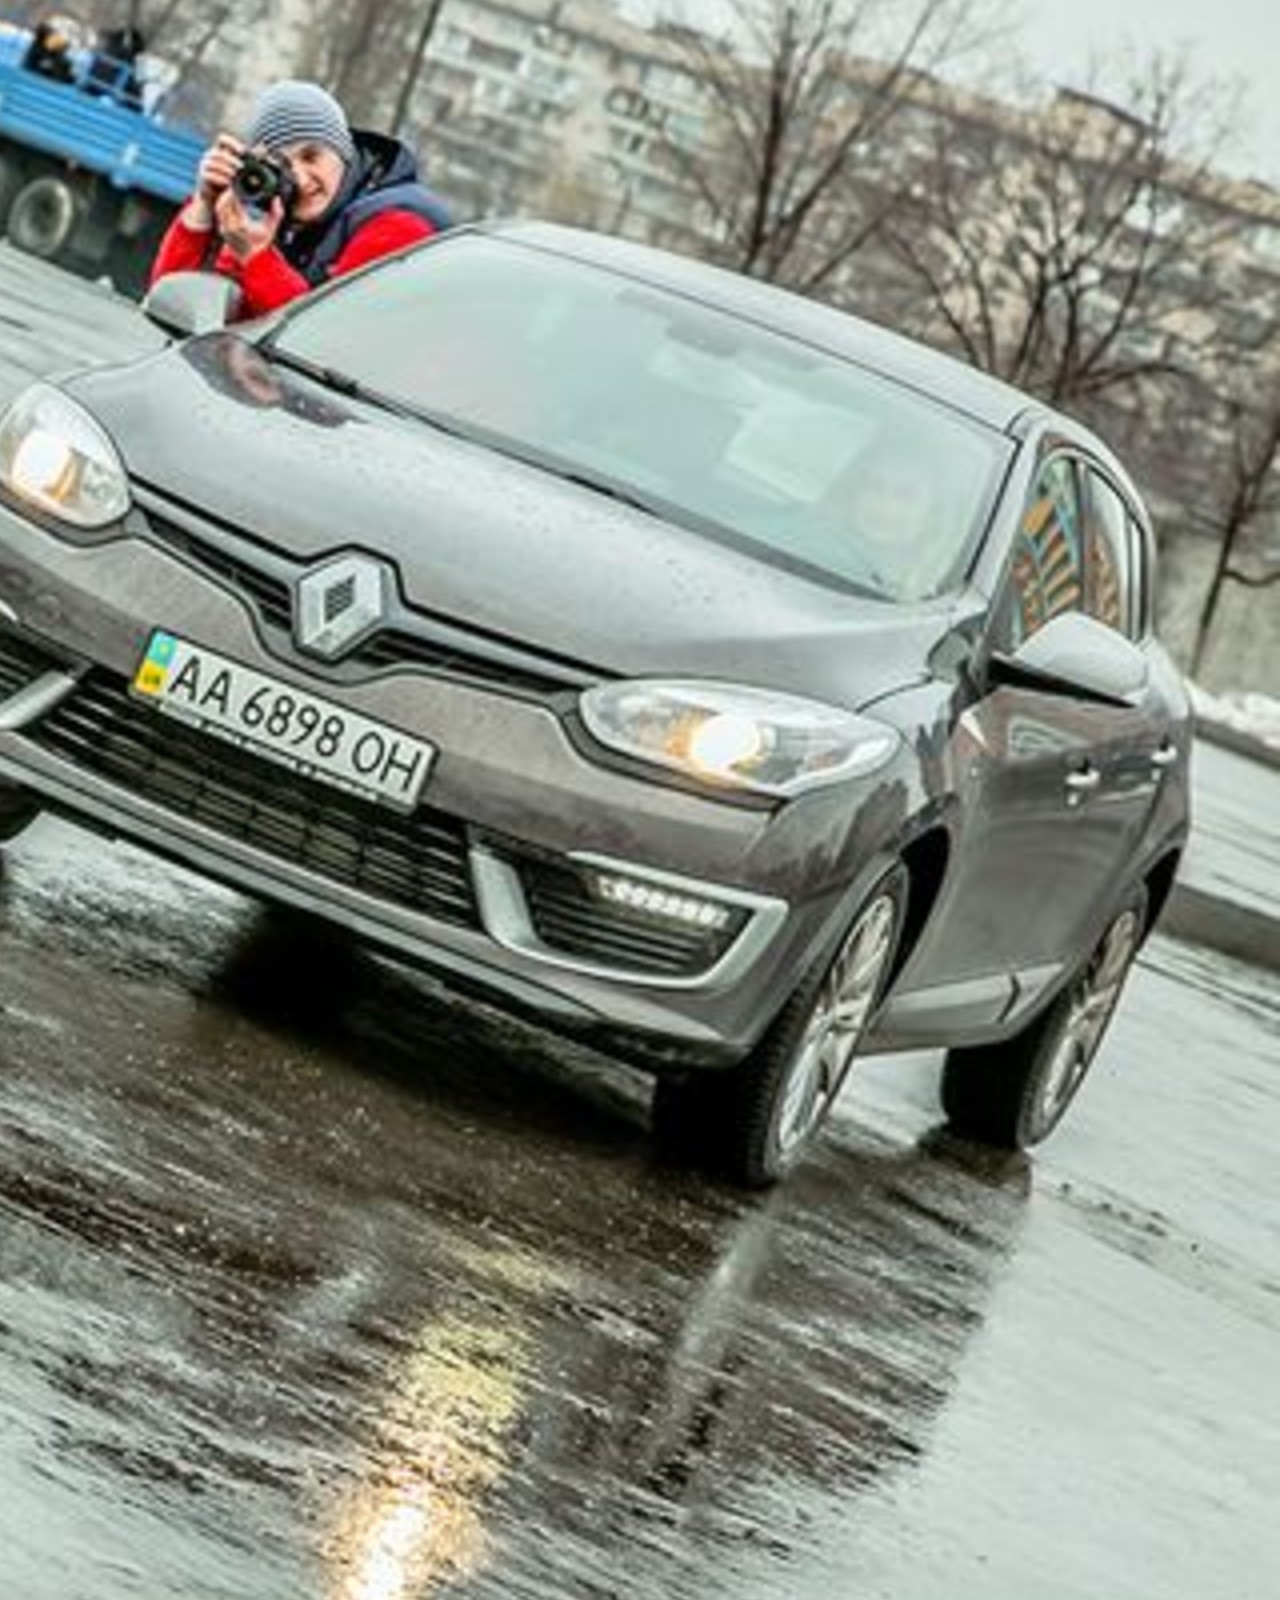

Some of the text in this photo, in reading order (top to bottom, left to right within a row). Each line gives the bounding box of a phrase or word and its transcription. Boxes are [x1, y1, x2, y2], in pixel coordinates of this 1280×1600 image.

[168, 656, 421, 791] AA 6898 OH
